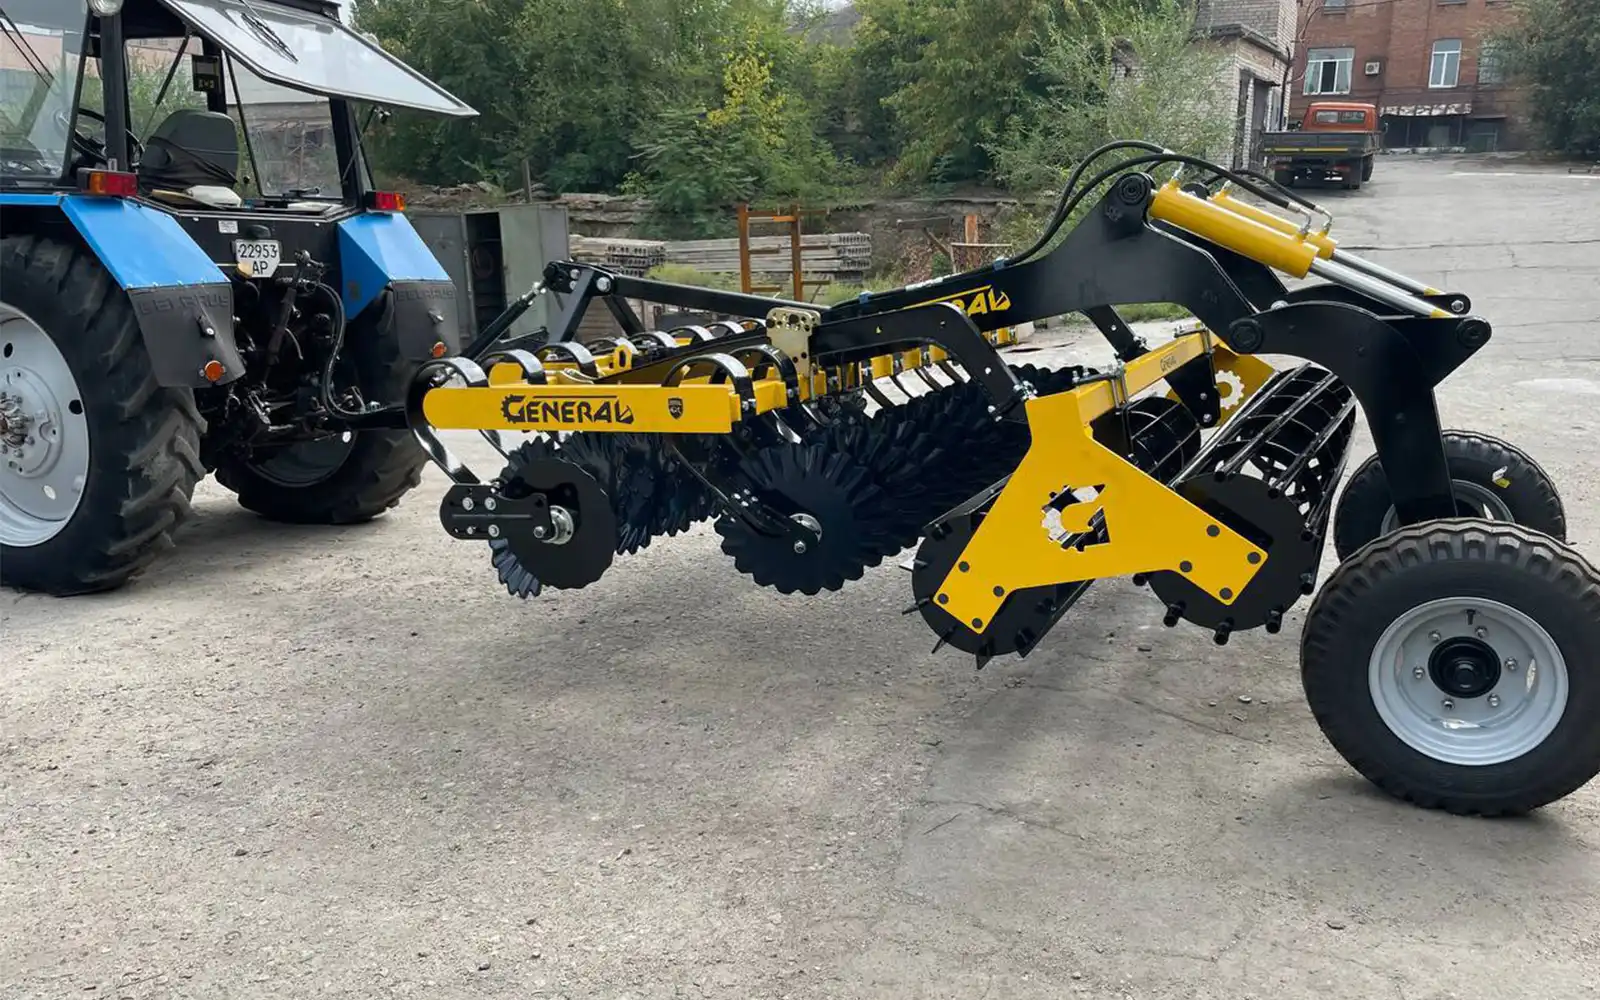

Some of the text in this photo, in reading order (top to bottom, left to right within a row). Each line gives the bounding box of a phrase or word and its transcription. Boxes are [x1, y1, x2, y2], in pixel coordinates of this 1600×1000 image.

[239, 243, 277, 258] 22953
[252, 260, 269, 275] AP
[501, 394, 634, 424] GENERAL
